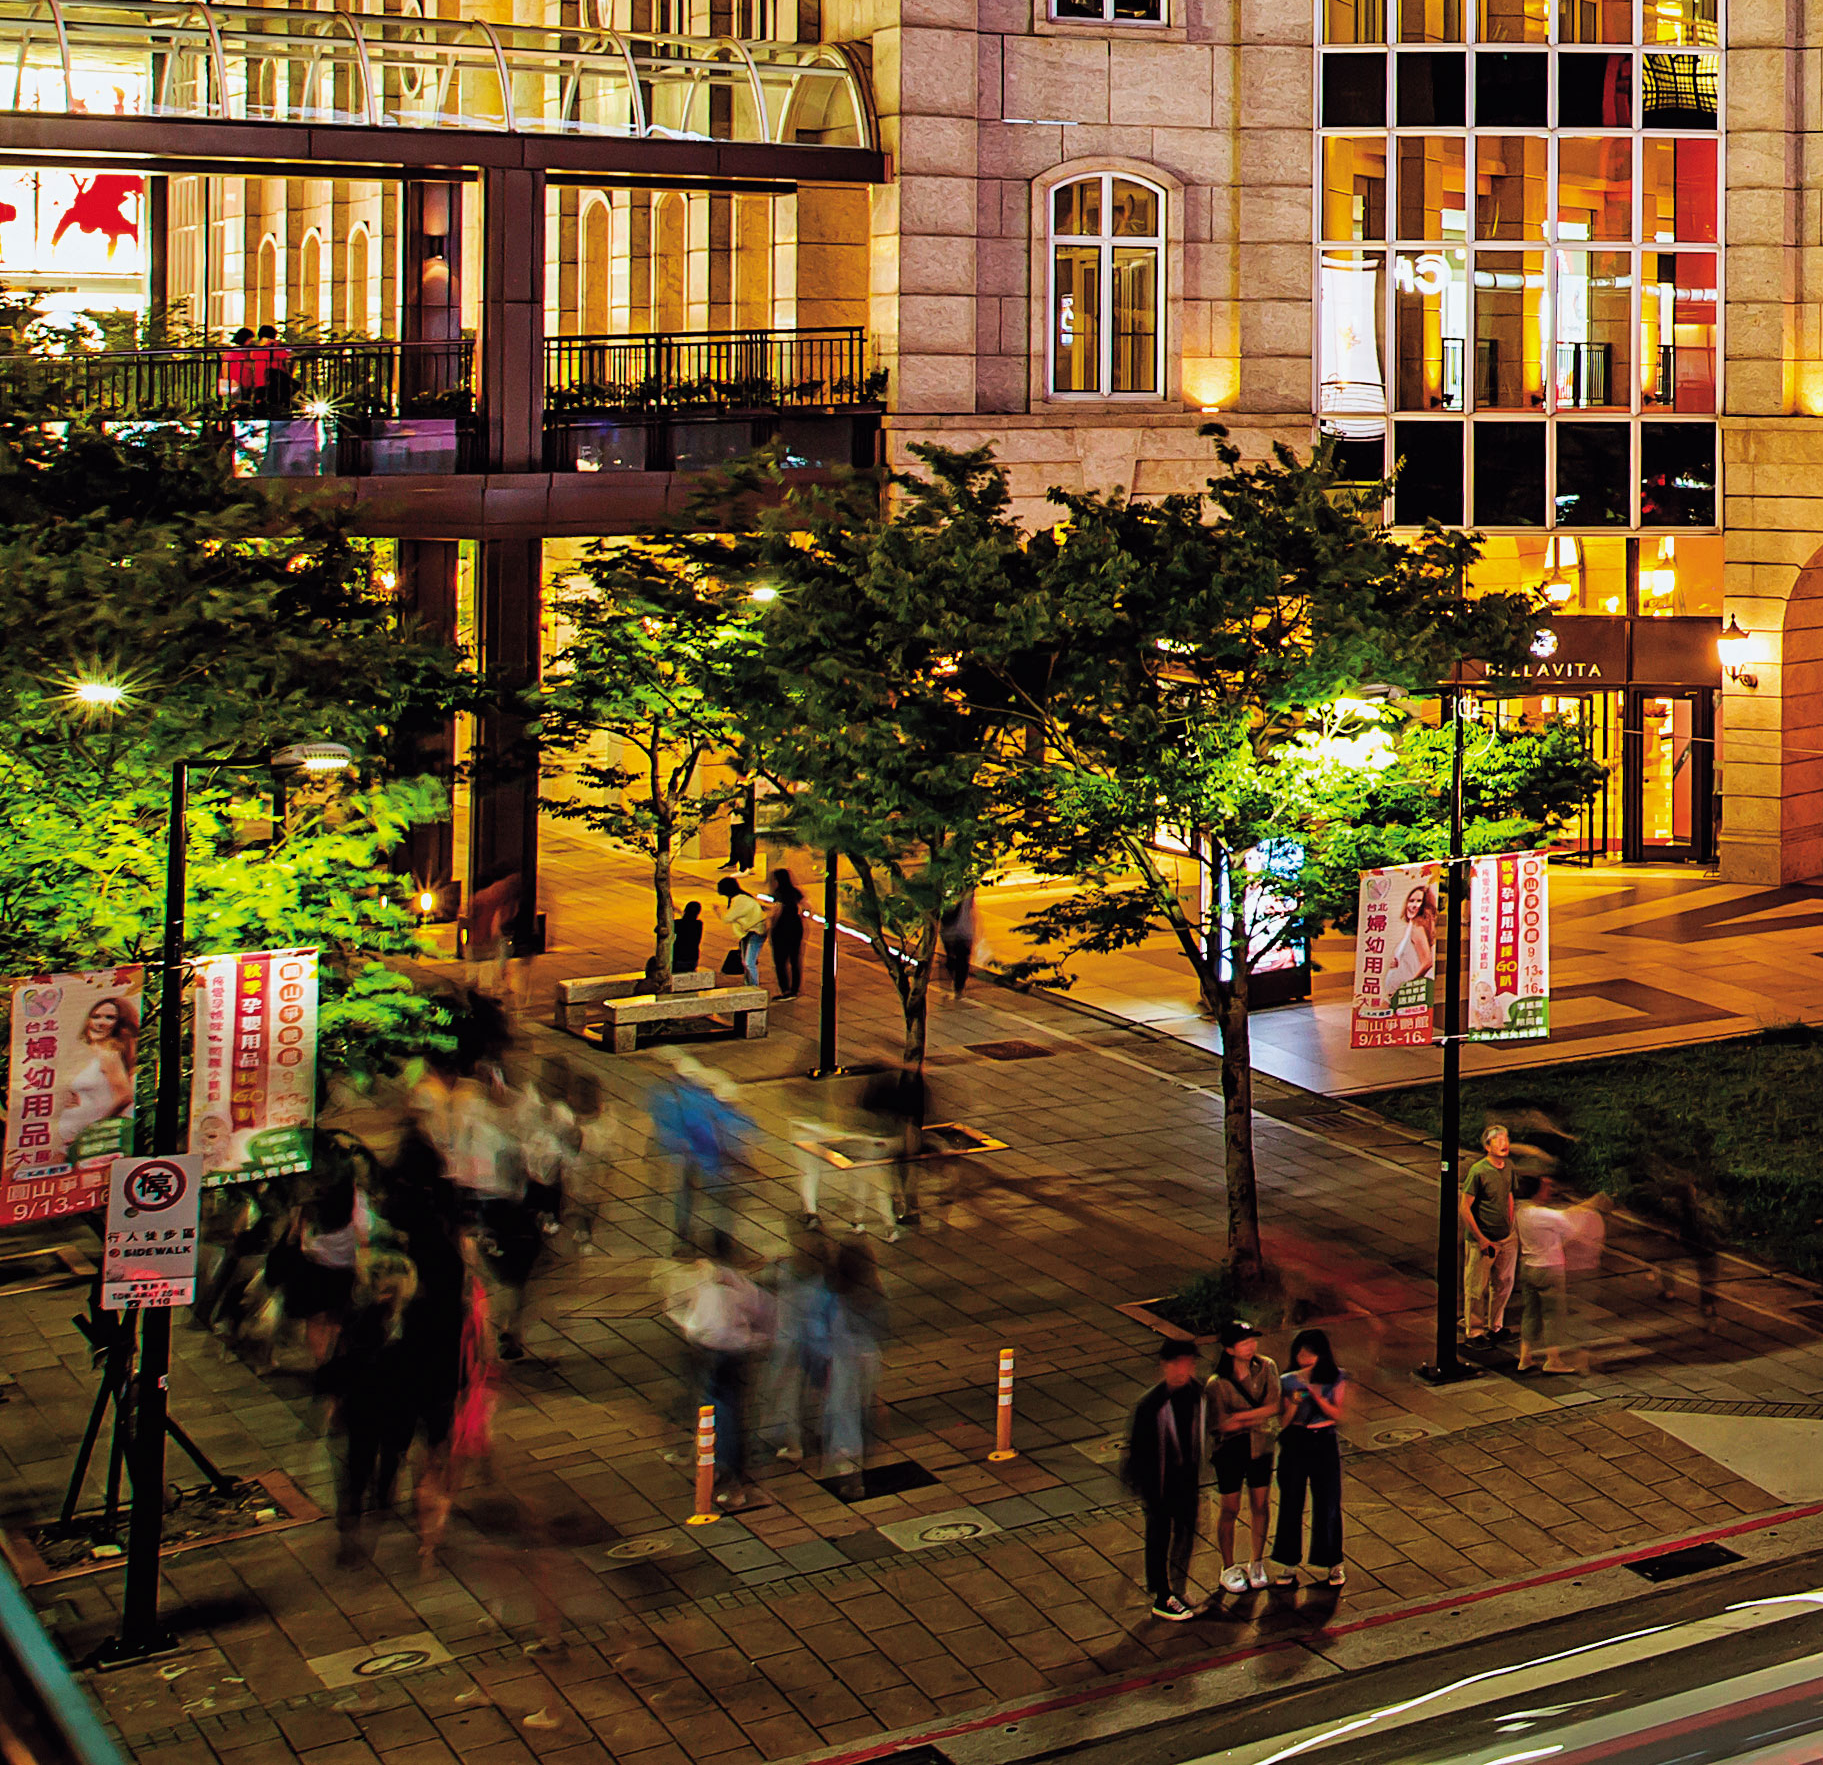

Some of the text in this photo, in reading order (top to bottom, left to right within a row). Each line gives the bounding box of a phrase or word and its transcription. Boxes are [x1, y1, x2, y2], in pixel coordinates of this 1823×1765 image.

[1366, 903, 1388, 912] 台北
[1362, 914, 1387, 995] 婦幼用品
[26, 1020, 59, 1033] 台北
[18, 1035, 58, 1148] 婦幼用品
[137, 1173, 172, 1201] 停
[108, 1228, 195, 1242] 行人徒步區
[124, 1246, 191, 1257] SIDEWALK
